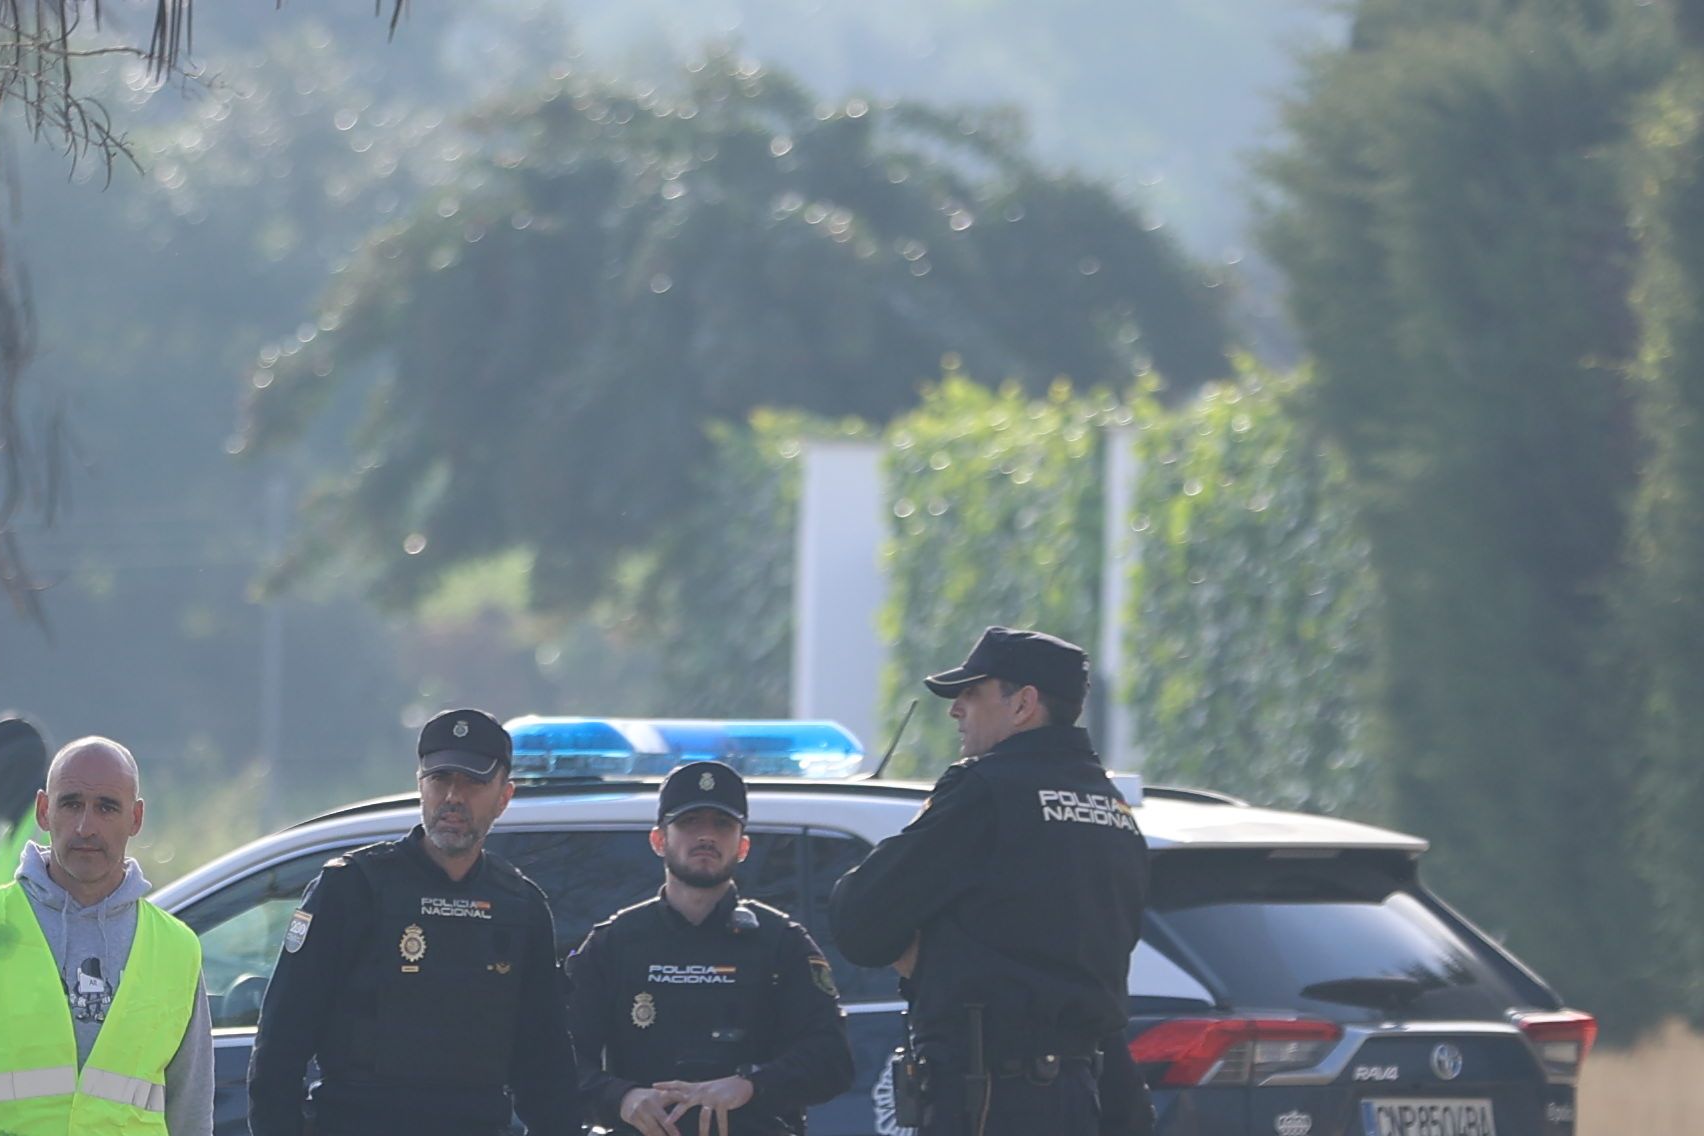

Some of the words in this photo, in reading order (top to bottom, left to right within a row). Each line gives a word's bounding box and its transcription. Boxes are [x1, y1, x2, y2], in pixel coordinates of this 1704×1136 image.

[421, 897, 478, 909] POLICIA
[421, 906, 492, 919] NACIONAL
[649, 965, 717, 974] POLICIA
[648, 974, 736, 984] NACIONAL
[1353, 1066, 1399, 1081] RAV4
